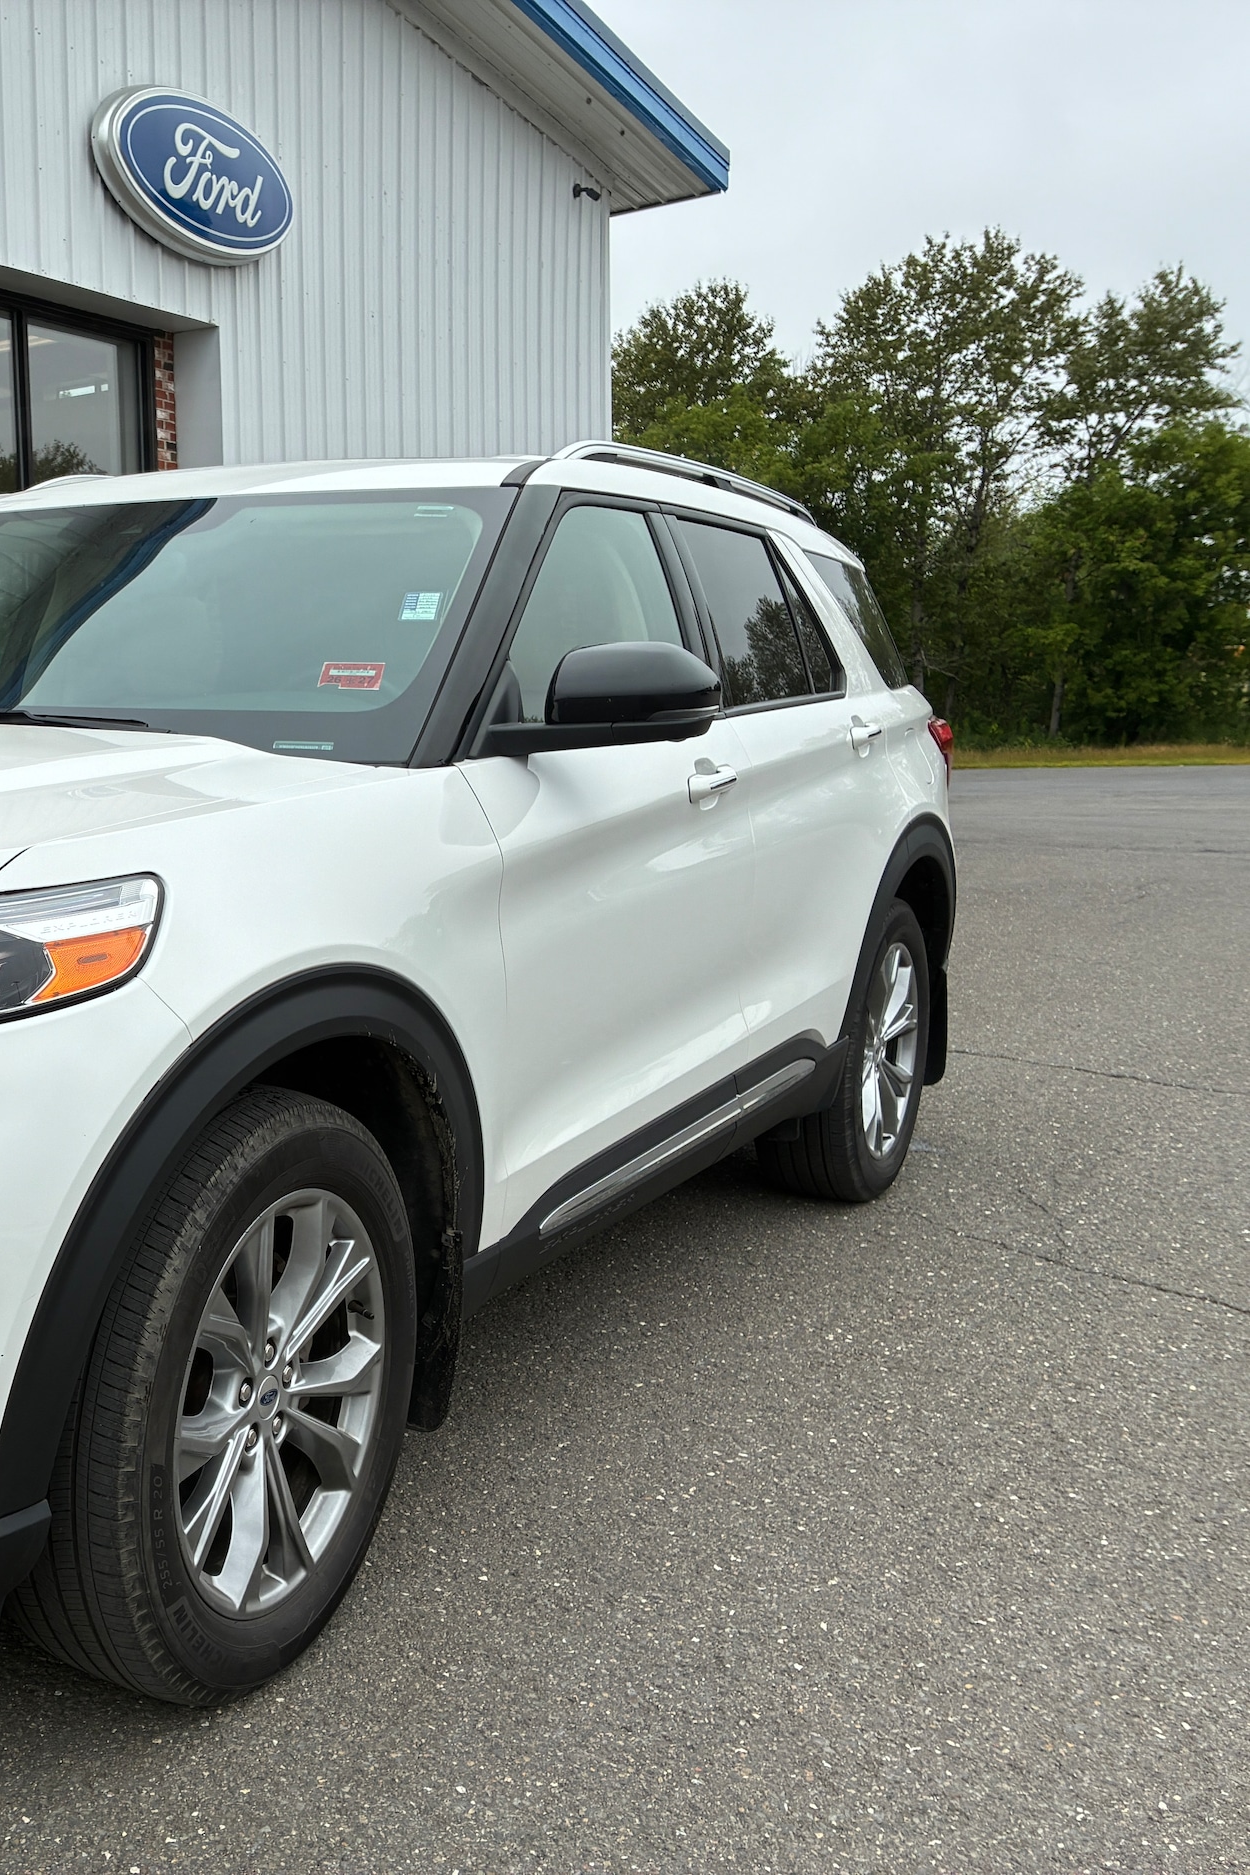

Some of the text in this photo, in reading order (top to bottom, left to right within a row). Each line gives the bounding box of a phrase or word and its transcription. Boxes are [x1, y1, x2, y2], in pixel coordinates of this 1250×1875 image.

[163, 122, 264, 228] Ford
[153, 1475, 173, 1591] 255/55 R 20
[172, 1603, 240, 1668] ICHELIN
